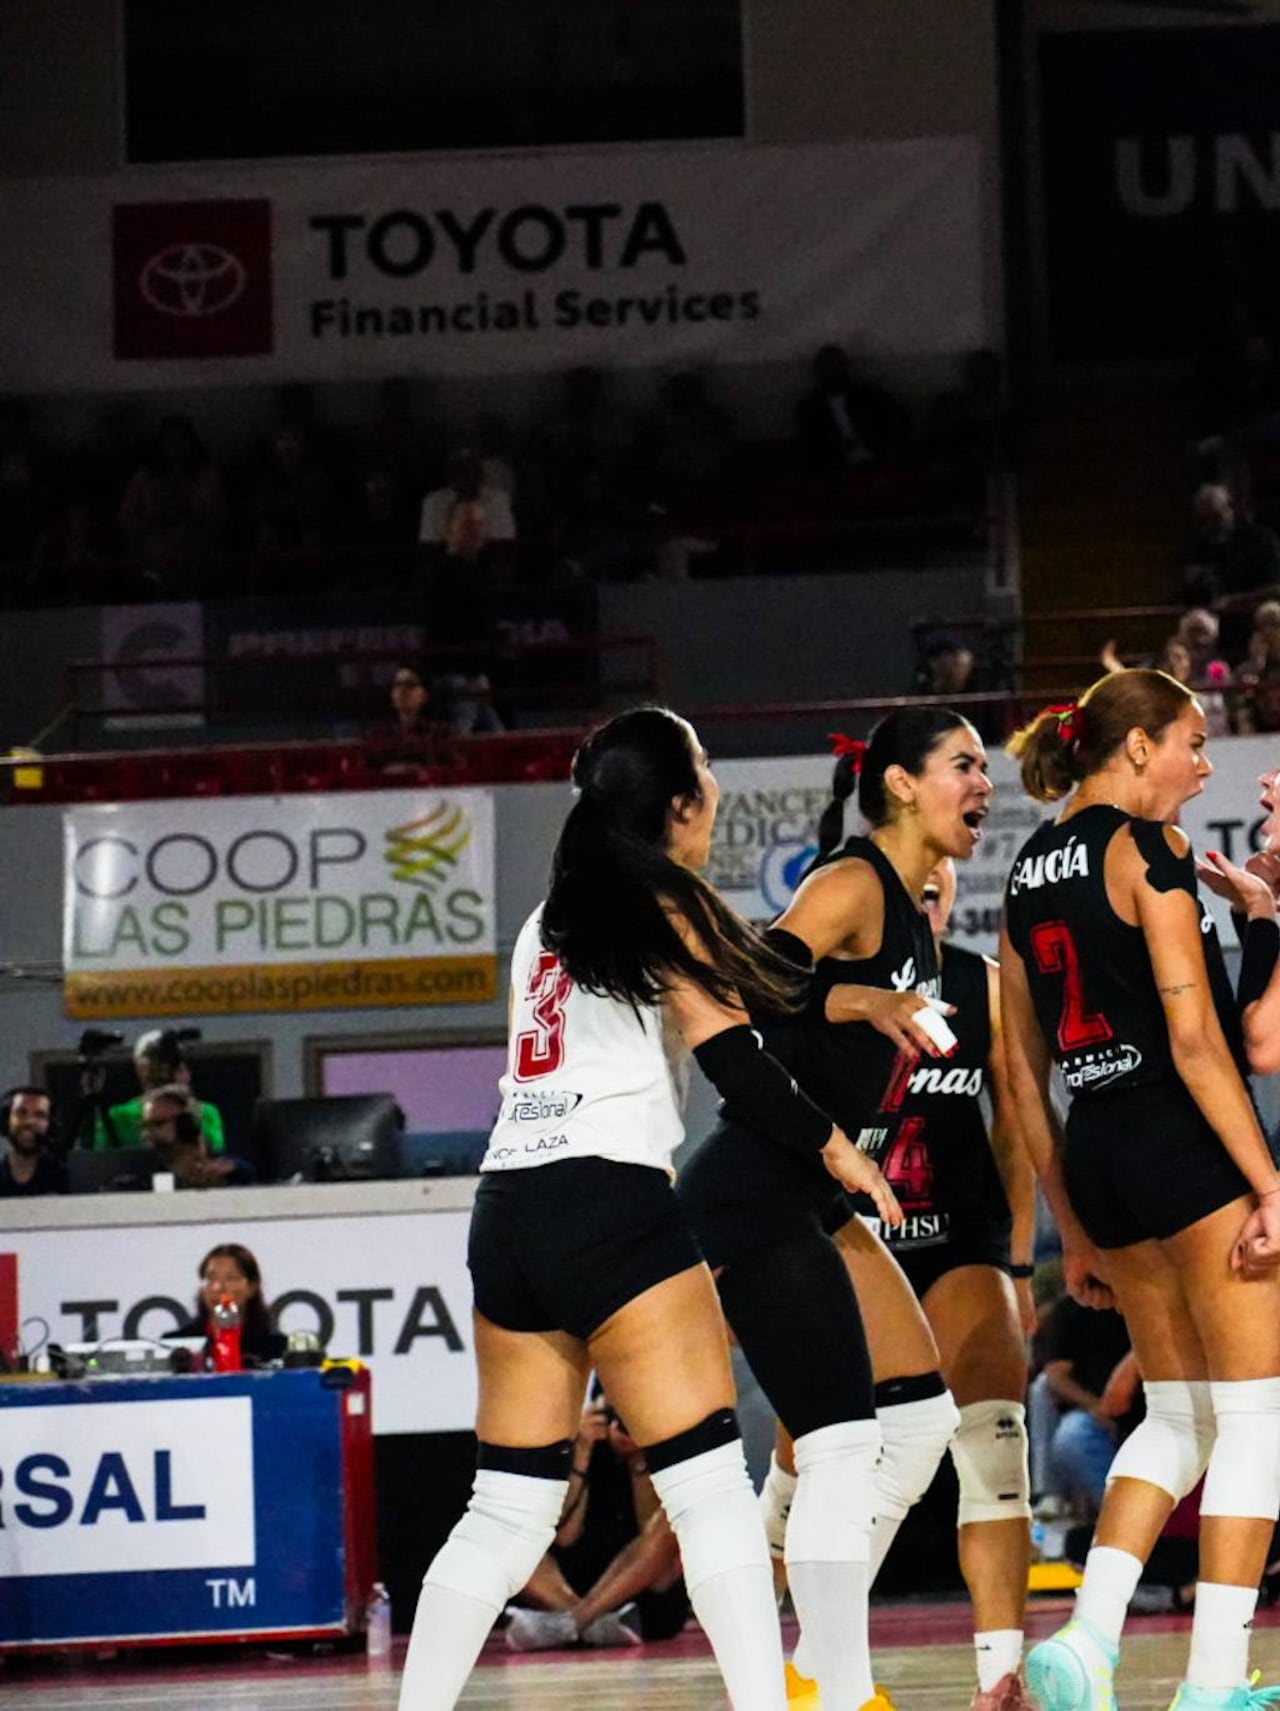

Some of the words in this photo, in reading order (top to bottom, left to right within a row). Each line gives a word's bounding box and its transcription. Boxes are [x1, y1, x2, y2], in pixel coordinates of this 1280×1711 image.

[310, 202, 686, 278] TOYOTA
[311, 291, 538, 338] Financial
[556, 285, 760, 328] Services
[75, 828, 367, 898] COOP
[73, 900, 190, 959] LAS
[216, 888, 486, 952] PIEDRAS
[77, 964, 487, 1006] www.cooplaspiedras.com
[514, 951, 573, 1084] 3
[1032, 920, 1113, 1051] 2
[61, 1286, 465, 1357] TOOTA
[0, 1450, 206, 1530] SAL
[207, 1579, 256, 1607] TM
